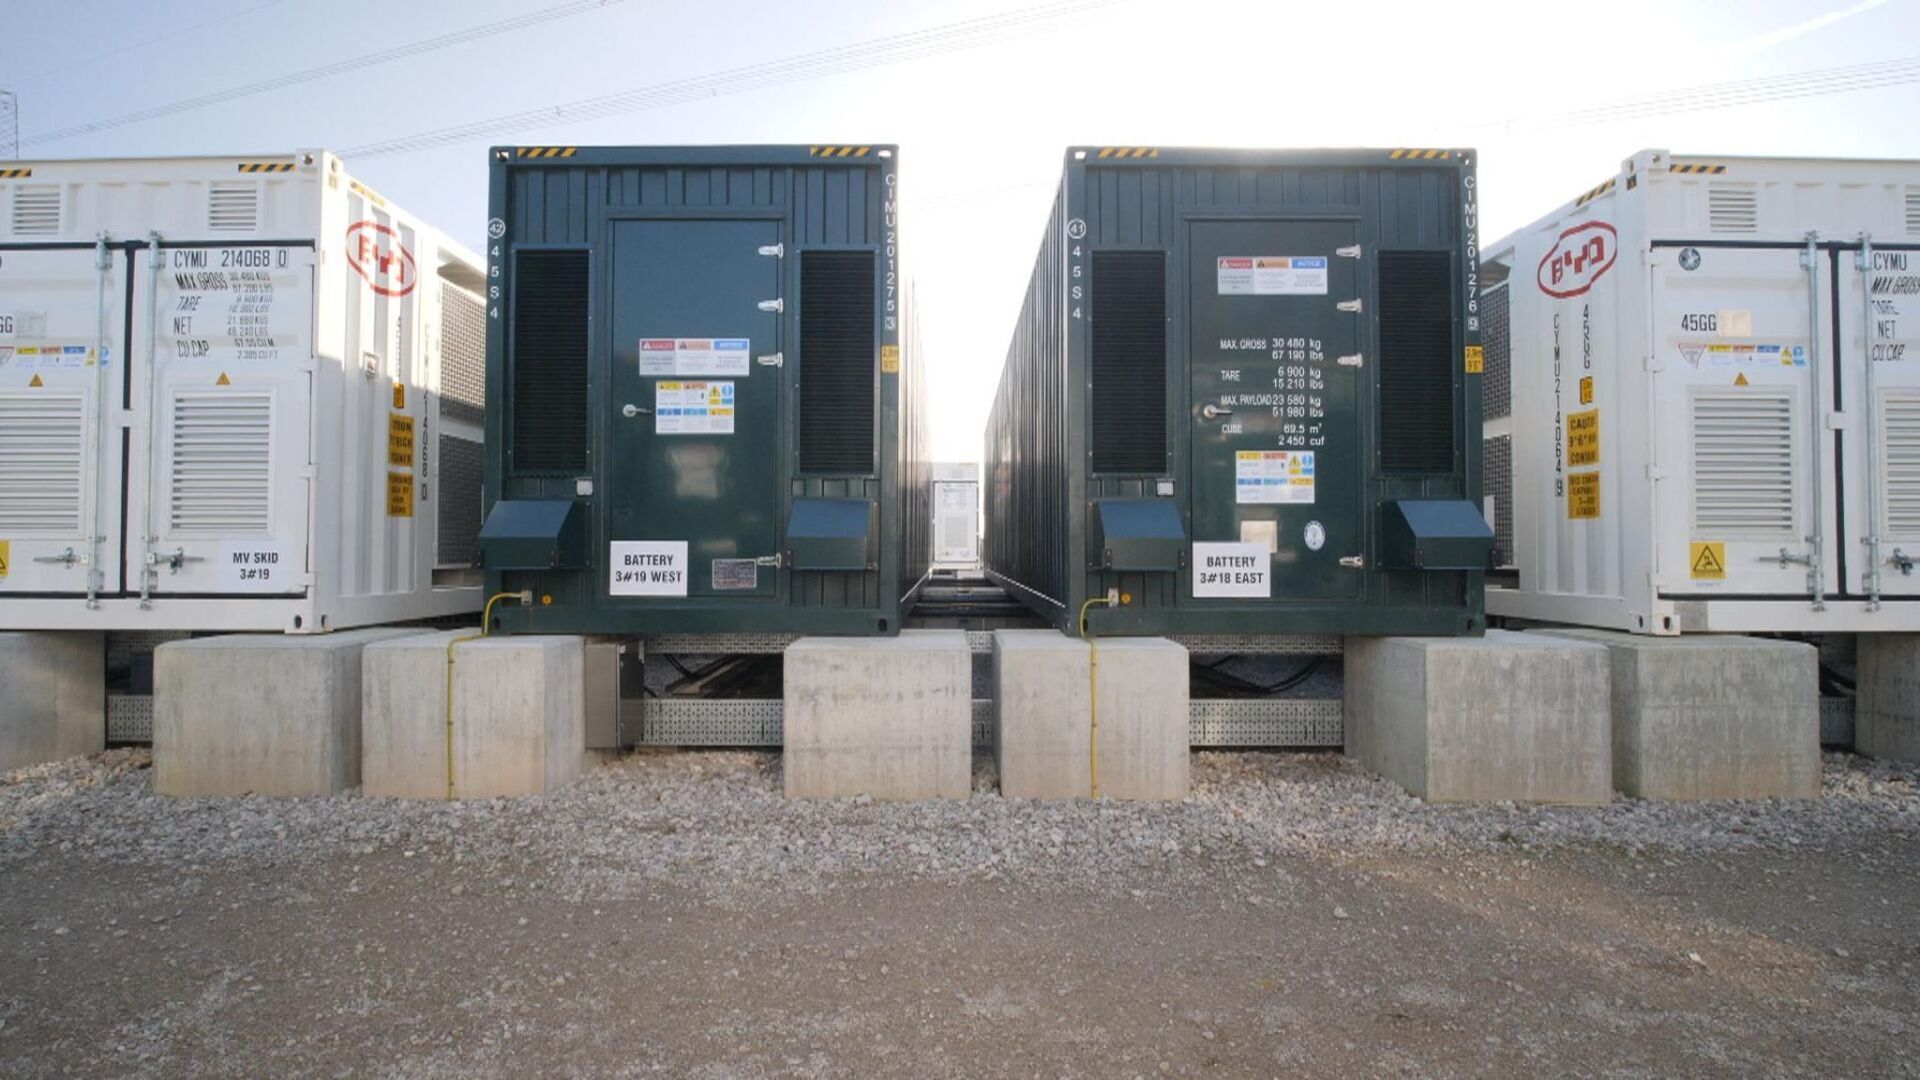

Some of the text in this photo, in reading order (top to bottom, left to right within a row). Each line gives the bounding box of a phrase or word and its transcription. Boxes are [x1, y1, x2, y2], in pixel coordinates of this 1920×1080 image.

[174, 250, 208, 268] CYMU
[221, 250, 270, 268] 214068
[1551, 237, 1604, 285] BYD
[1873, 253, 1907, 271] CYMU
[886, 232, 895, 311] 201275
[1467, 234, 1477, 312] 201276
[174, 317, 192, 335] NET
[1681, 314, 1716, 331] 45GG
[1878, 320, 1896, 339] NET
[1240, 340, 1266, 349] GROSS
[1273, 338, 1284, 348] 30
[1287, 338, 1305, 348] 480
[1310, 338, 1321, 350] kg
[1272, 350, 1284, 360] 67
[1310, 350, 1323, 360] lbs
[1221, 370, 1240, 380] TARE
[1287, 366, 1305, 377] 900
[1310, 366, 1321, 379] kg
[1273, 378, 1323, 389] 15 210 lbs
[1240, 395, 1272, 405] PAYLOAD
[1273, 394, 1284, 405] 23
[1287, 394, 1305, 405] 580
[1310, 394, 1321, 407] kg
[1287, 406, 1305, 417] 980
[1310, 406, 1323, 417] lbs
[1222, 424, 1242, 434] CUBE
[1283, 423, 1305, 434] 69.5
[1278, 436, 1284, 445] 2
[1287, 436, 1305, 445] 450
[233, 552, 279, 564] MV SKID
[625, 554, 674, 566] BATTERY
[1207, 556, 1256, 568] BATTERY
[240, 568, 270, 580] 3#19
[616, 570, 682, 582] 3#19 WEST
[1200, 572, 1264, 584] 3#18 EAST
